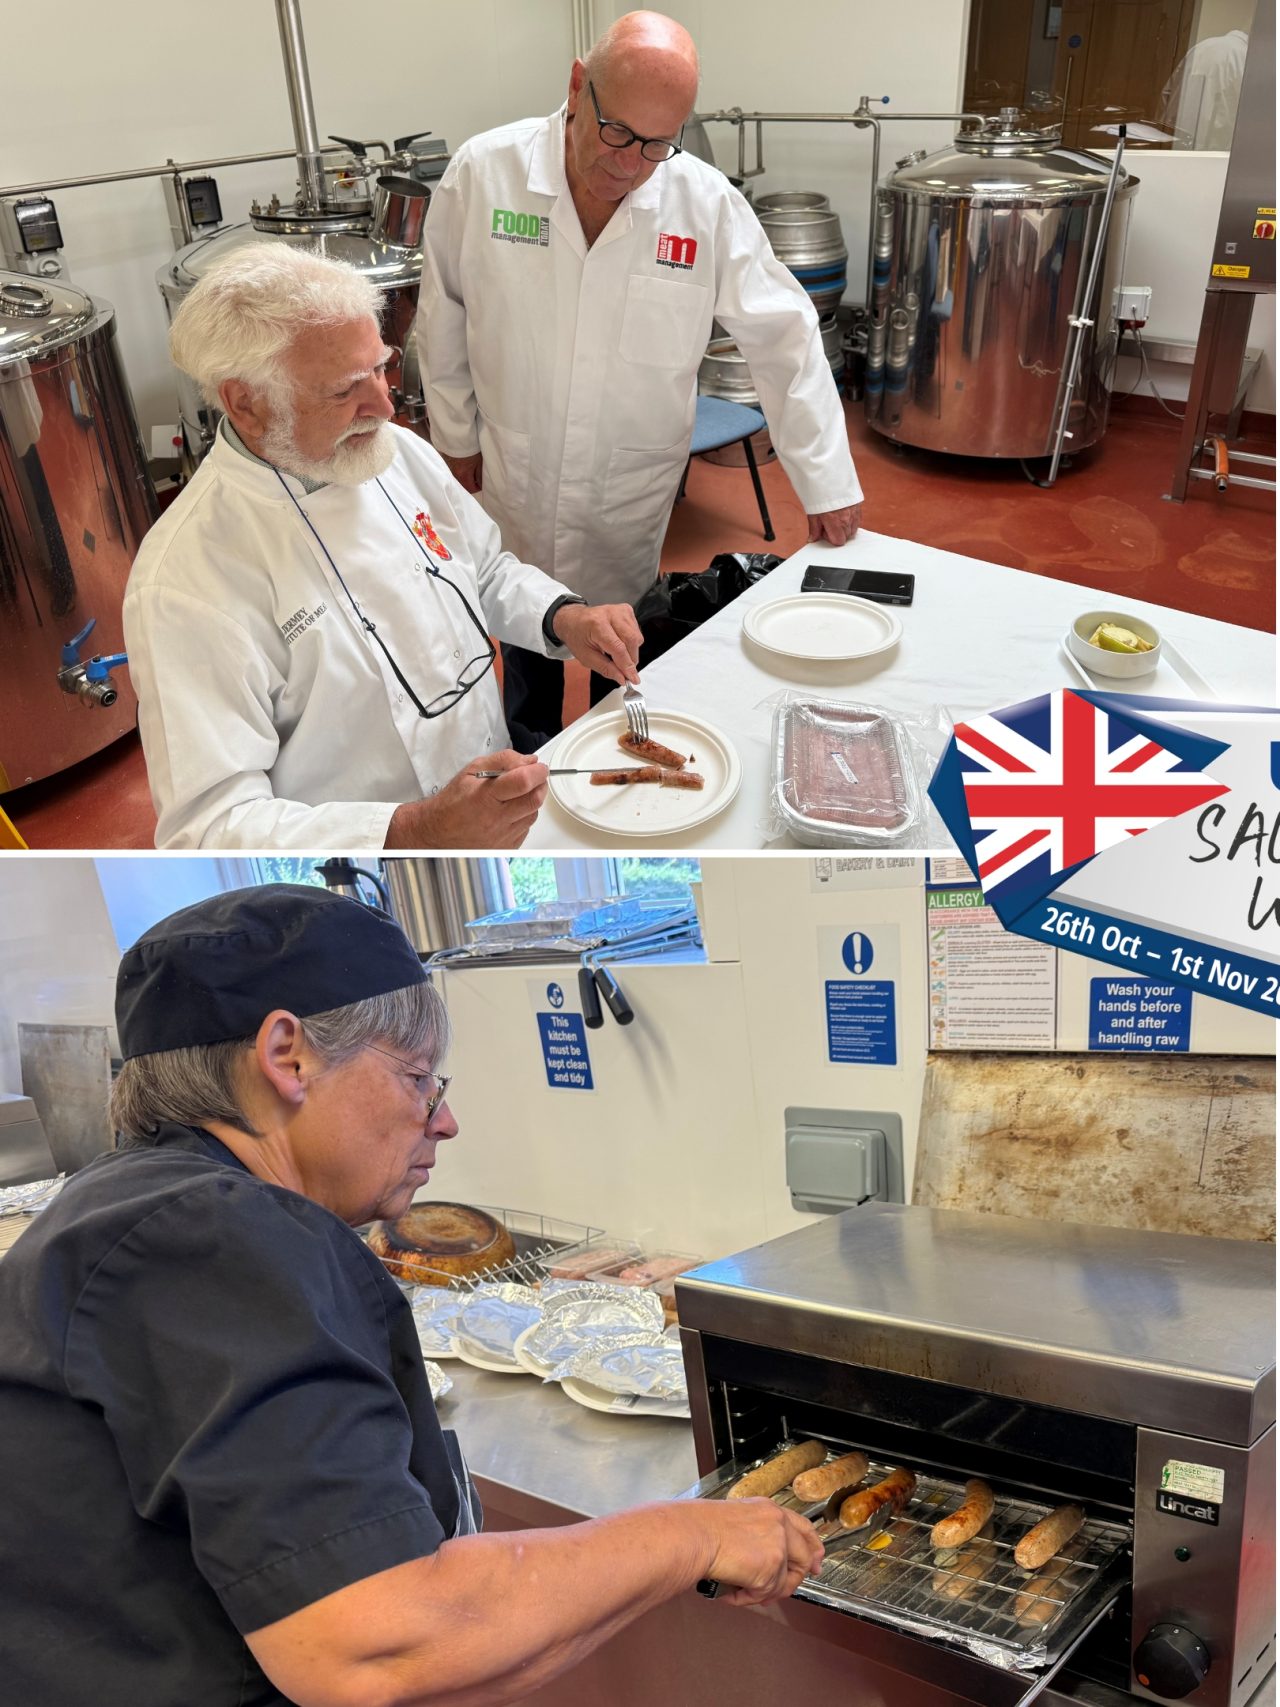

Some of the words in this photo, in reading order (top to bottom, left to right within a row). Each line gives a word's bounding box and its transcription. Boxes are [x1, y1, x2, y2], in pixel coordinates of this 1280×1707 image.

[492, 209, 540, 238] FOOD
[491, 232, 539, 245] management
[540, 219, 549, 244] TODAY
[658, 235, 668, 259] meat
[656, 259, 694, 270] management
[281, 607, 308, 635] JERMEY
[929, 893, 980, 908] ALLERGY
[1106, 983, 1142, 996] Wash
[1144, 986, 1175, 999] your
[1098, 1000, 1137, 1012] hands
[1140, 1000, 1182, 1013] before
[550, 1016, 570, 1028] This
[1110, 1016, 1135, 1028] and
[1137, 1016, 1168, 1028] after
[548, 1031, 578, 1042] kitchen
[1098, 1032, 1153, 1048] handling
[1155, 1036, 1180, 1046] raw
[550, 1045, 570, 1056] must
[570, 1046, 581, 1056] be
[547, 1058, 566, 1070] kept
[566, 1059, 588, 1070] clean
[554, 1072, 569, 1083] and
[570, 1073, 586, 1086] tidy
[1160, 1495, 1216, 1521] Lincat
